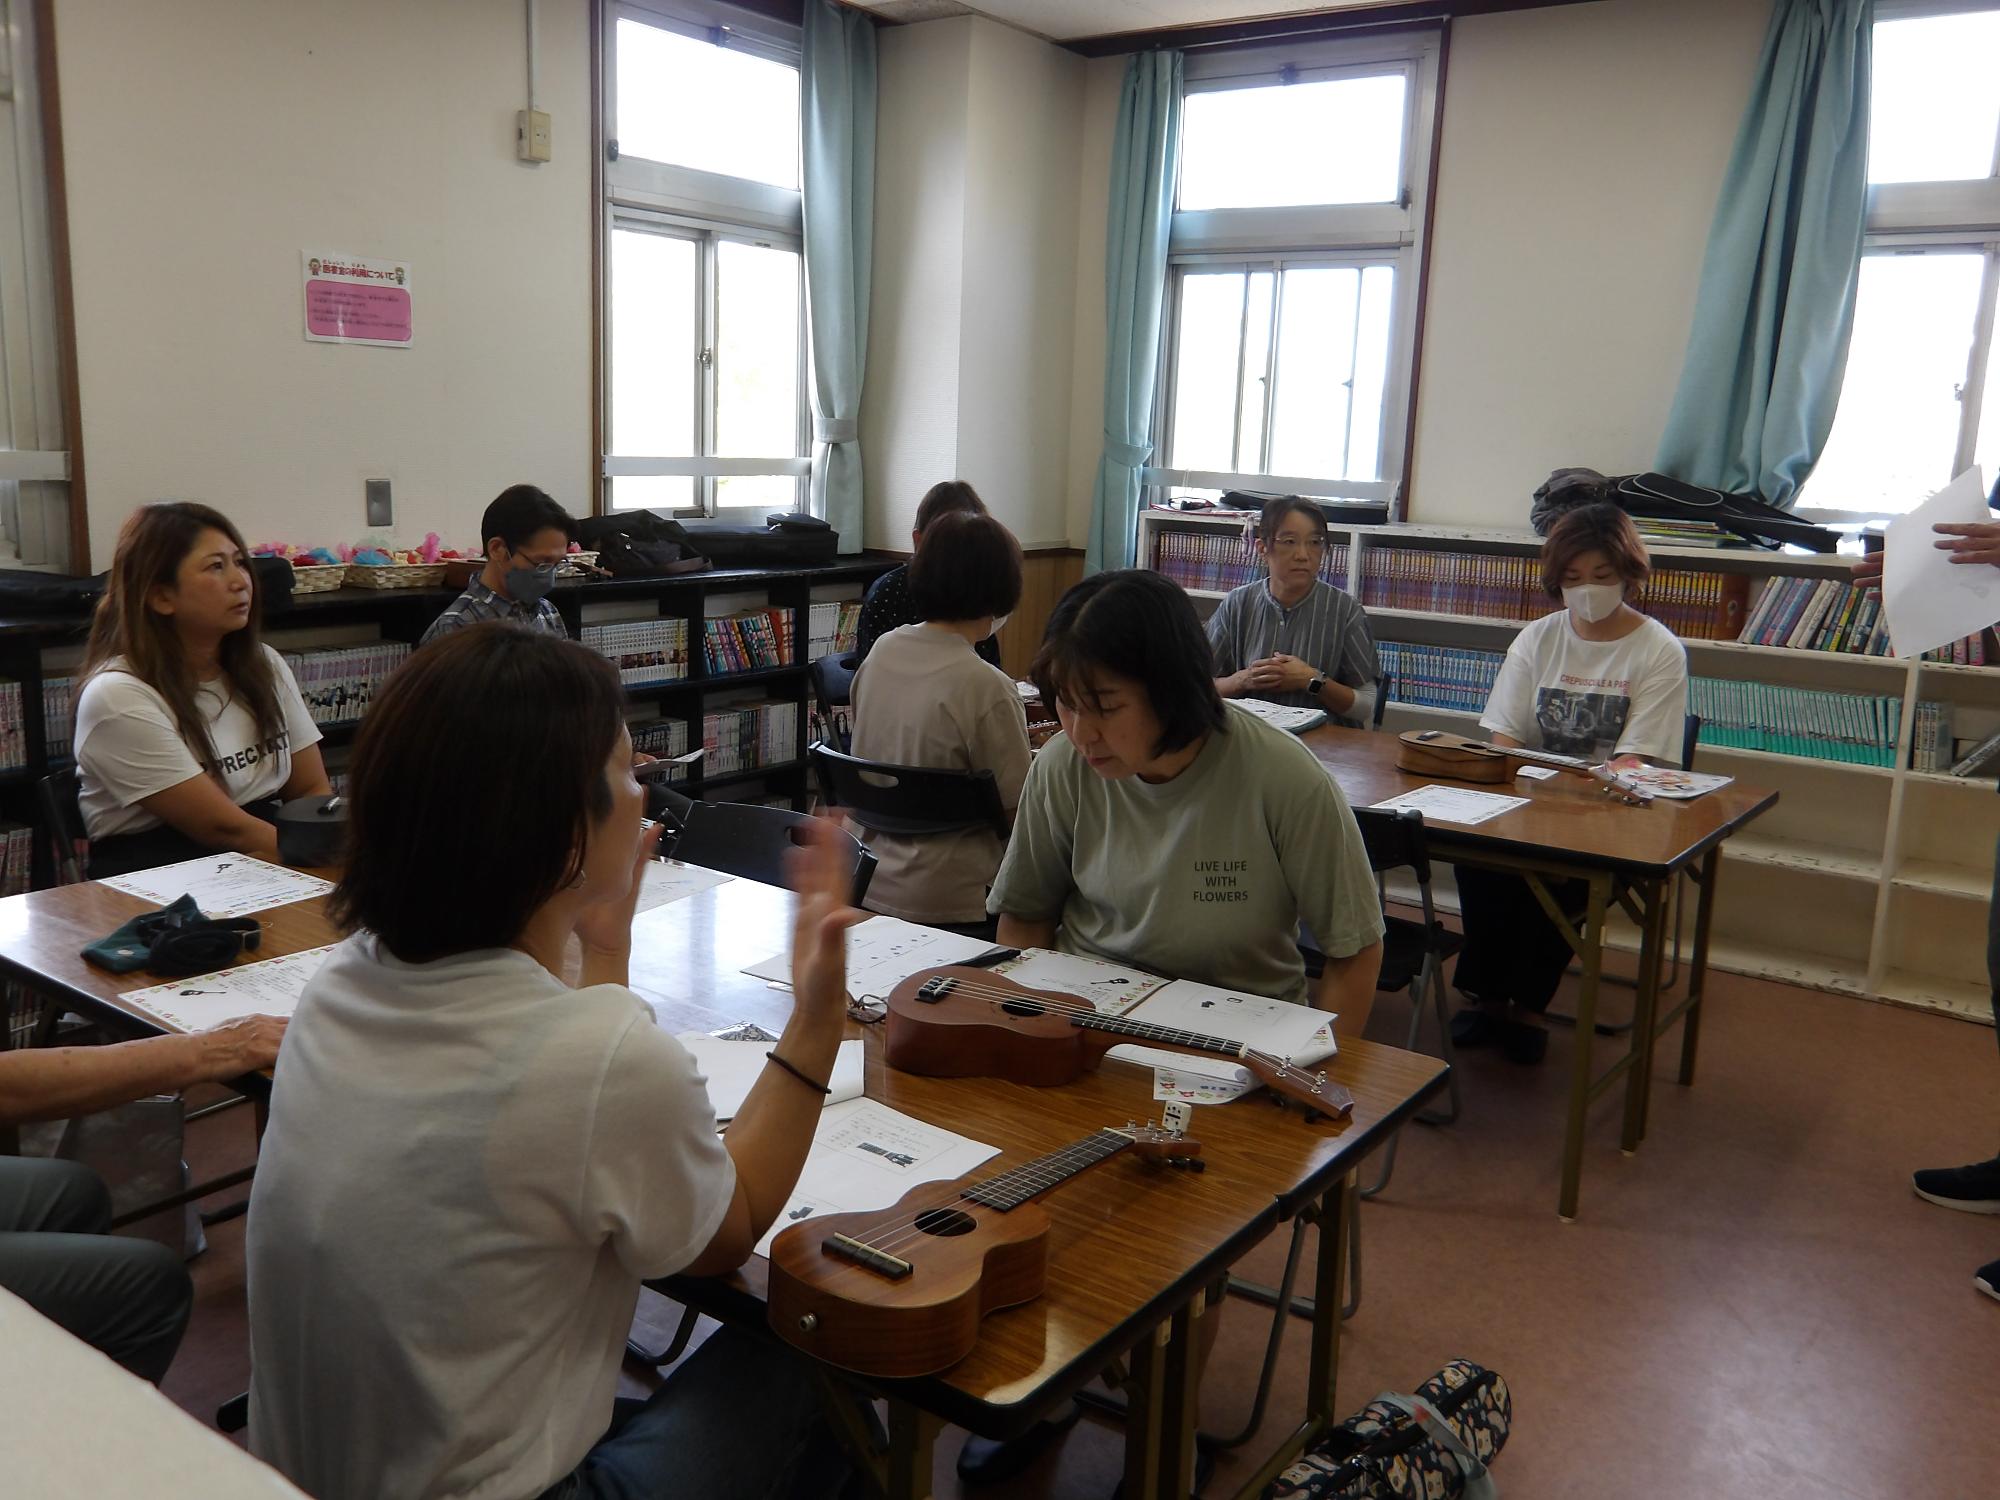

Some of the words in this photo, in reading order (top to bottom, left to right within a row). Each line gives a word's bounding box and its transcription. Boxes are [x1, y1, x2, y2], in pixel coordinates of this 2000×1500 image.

[1194, 860, 1220, 872] LIVE
[1223, 860, 1247, 872] LIFE
[1205, 876, 1236, 887] WITH
[1193, 891, 1249, 902] FLOWERS
